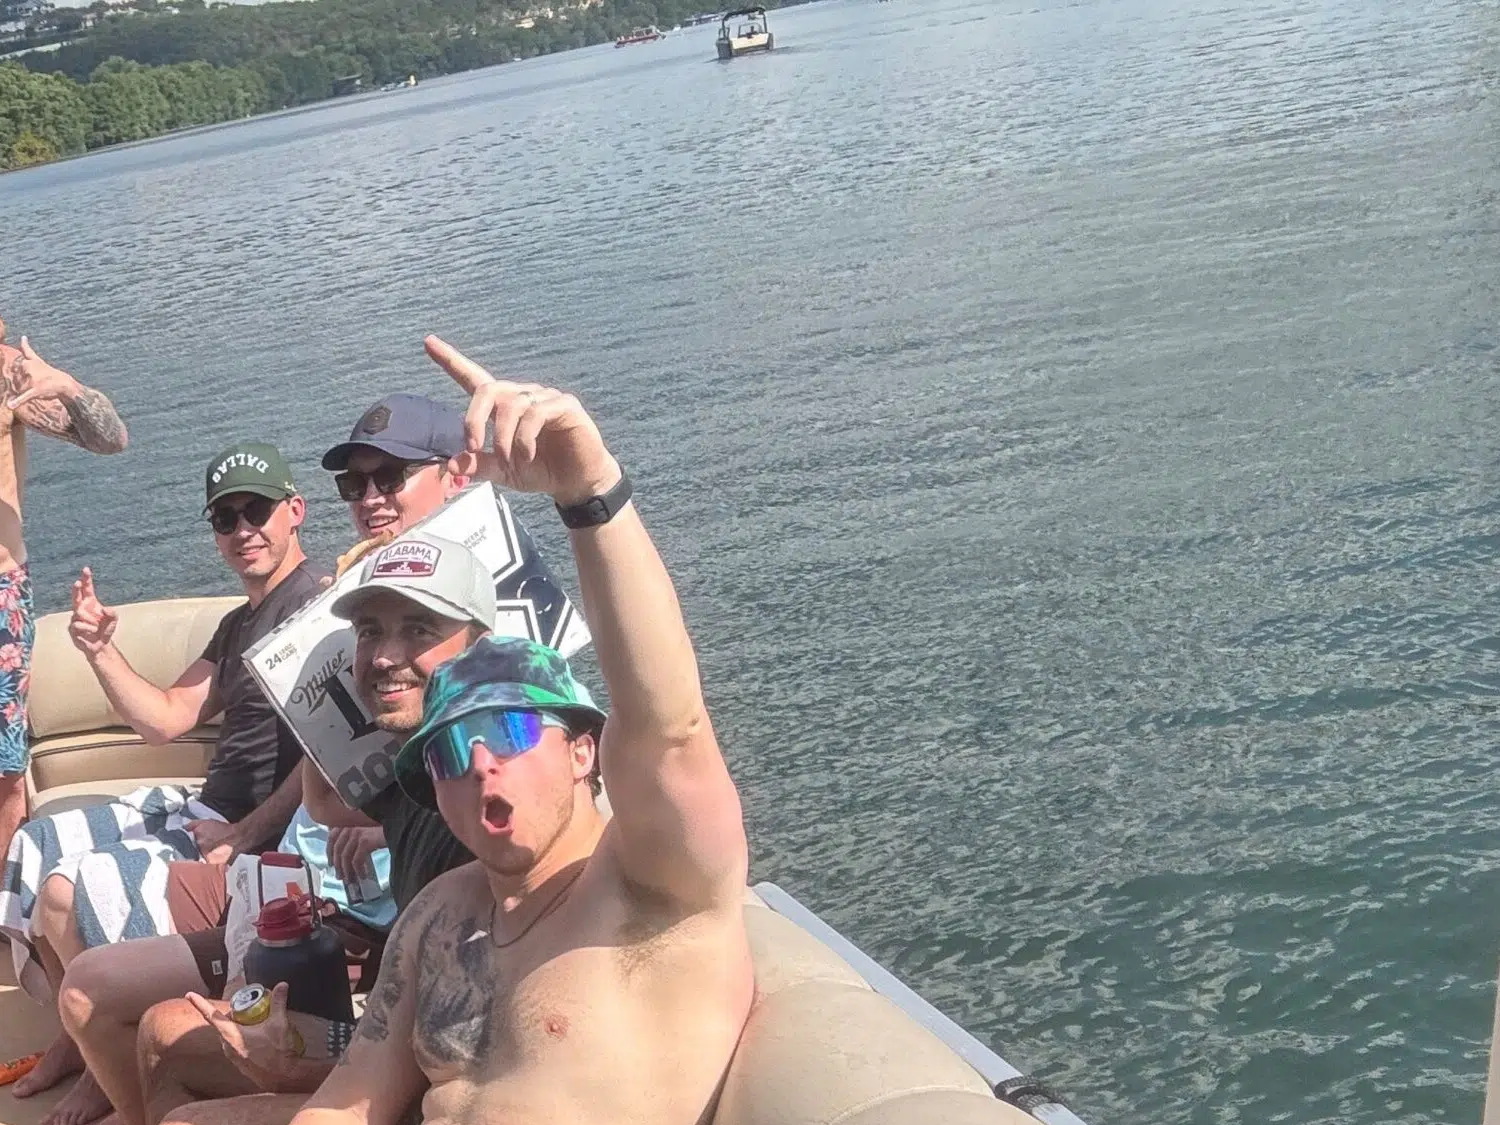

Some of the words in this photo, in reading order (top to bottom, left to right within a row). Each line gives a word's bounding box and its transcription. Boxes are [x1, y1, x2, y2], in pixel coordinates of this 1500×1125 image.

[381, 545, 433, 561] ALABAMA
[265, 652, 283, 671] 24
[291, 648, 346, 711] Miller
